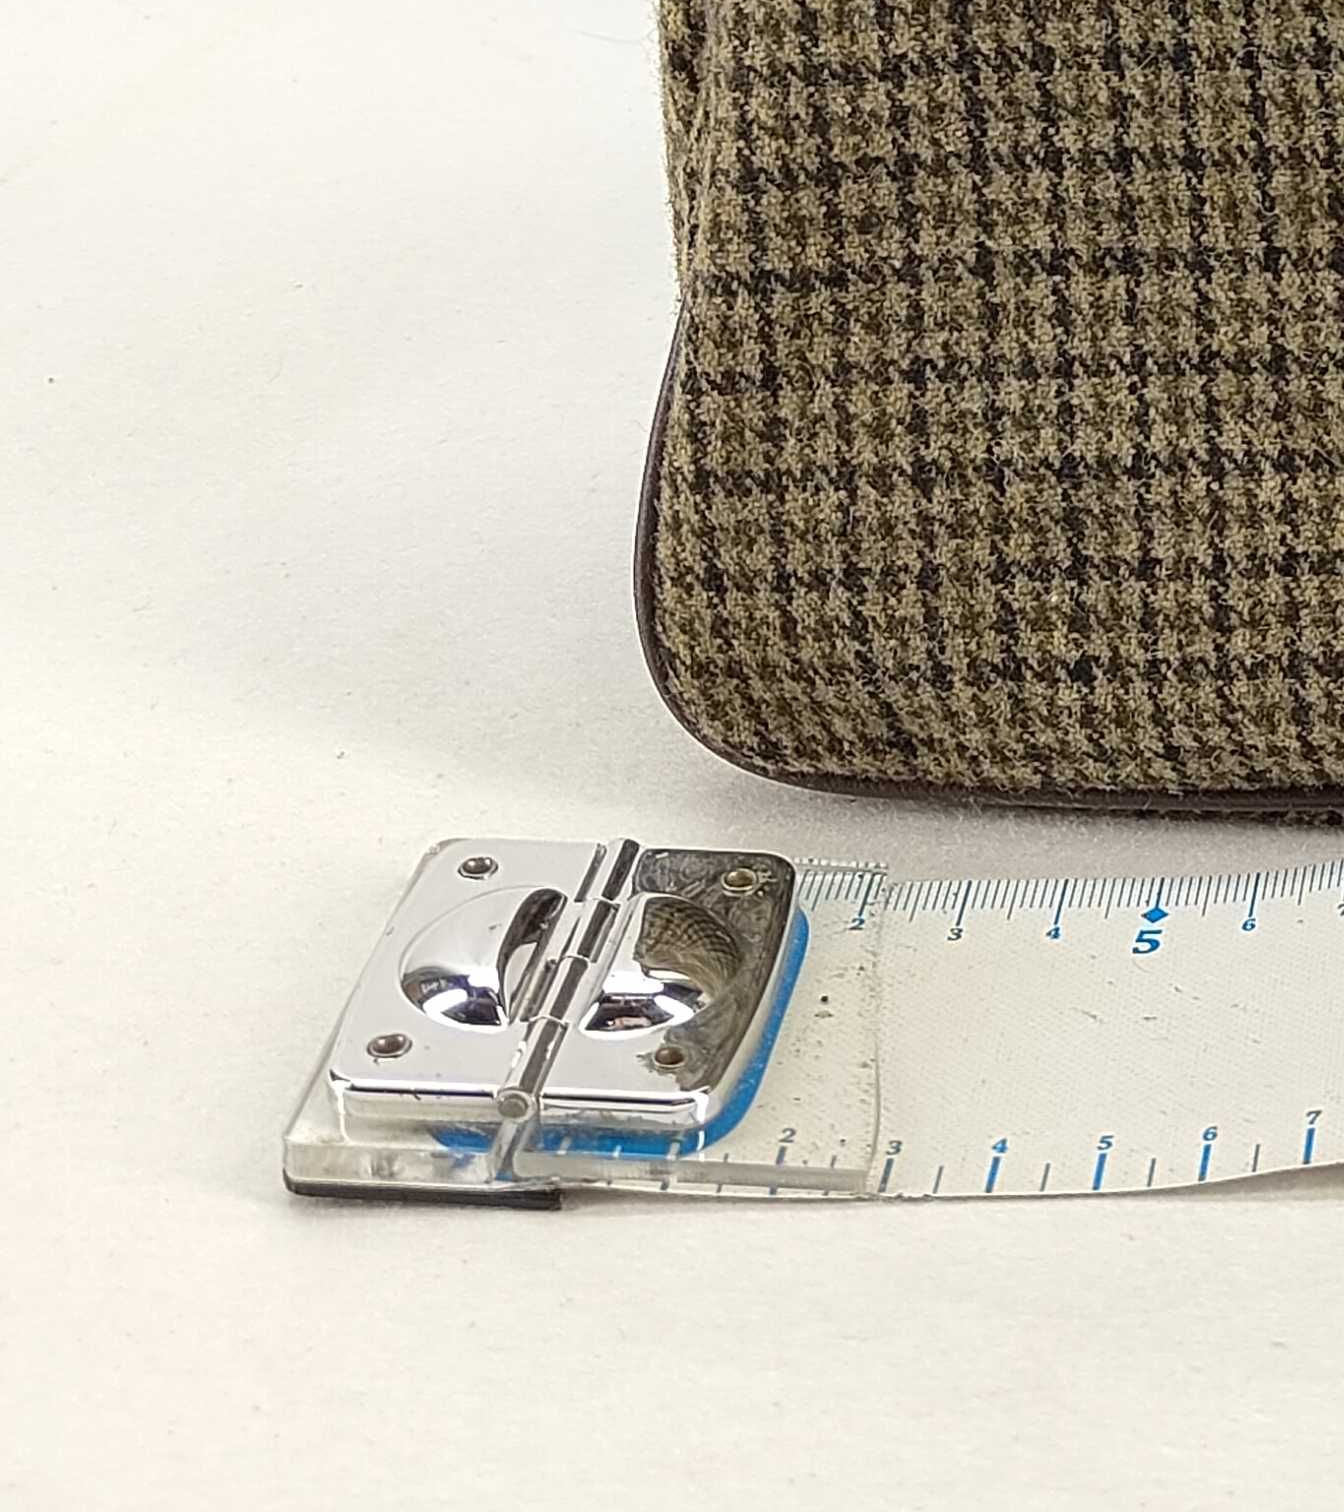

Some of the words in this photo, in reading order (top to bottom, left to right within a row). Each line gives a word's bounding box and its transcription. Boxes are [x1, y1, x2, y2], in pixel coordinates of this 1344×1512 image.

[851, 918, 865, 930] 2
[947, 928, 963, 941] 3
[1046, 927, 1060, 939] 4
[1132, 930, 1163, 953] 5
[1241, 919, 1256, 931] 6
[781, 1128, 796, 1143] 2
[886, 1140, 903, 1155] 3
[992, 1138, 1009, 1154] 4
[1097, 1135, 1114, 1151] 5
[1202, 1126, 1218, 1141] 6
[1306, 1110, 1321, 1125] 7
